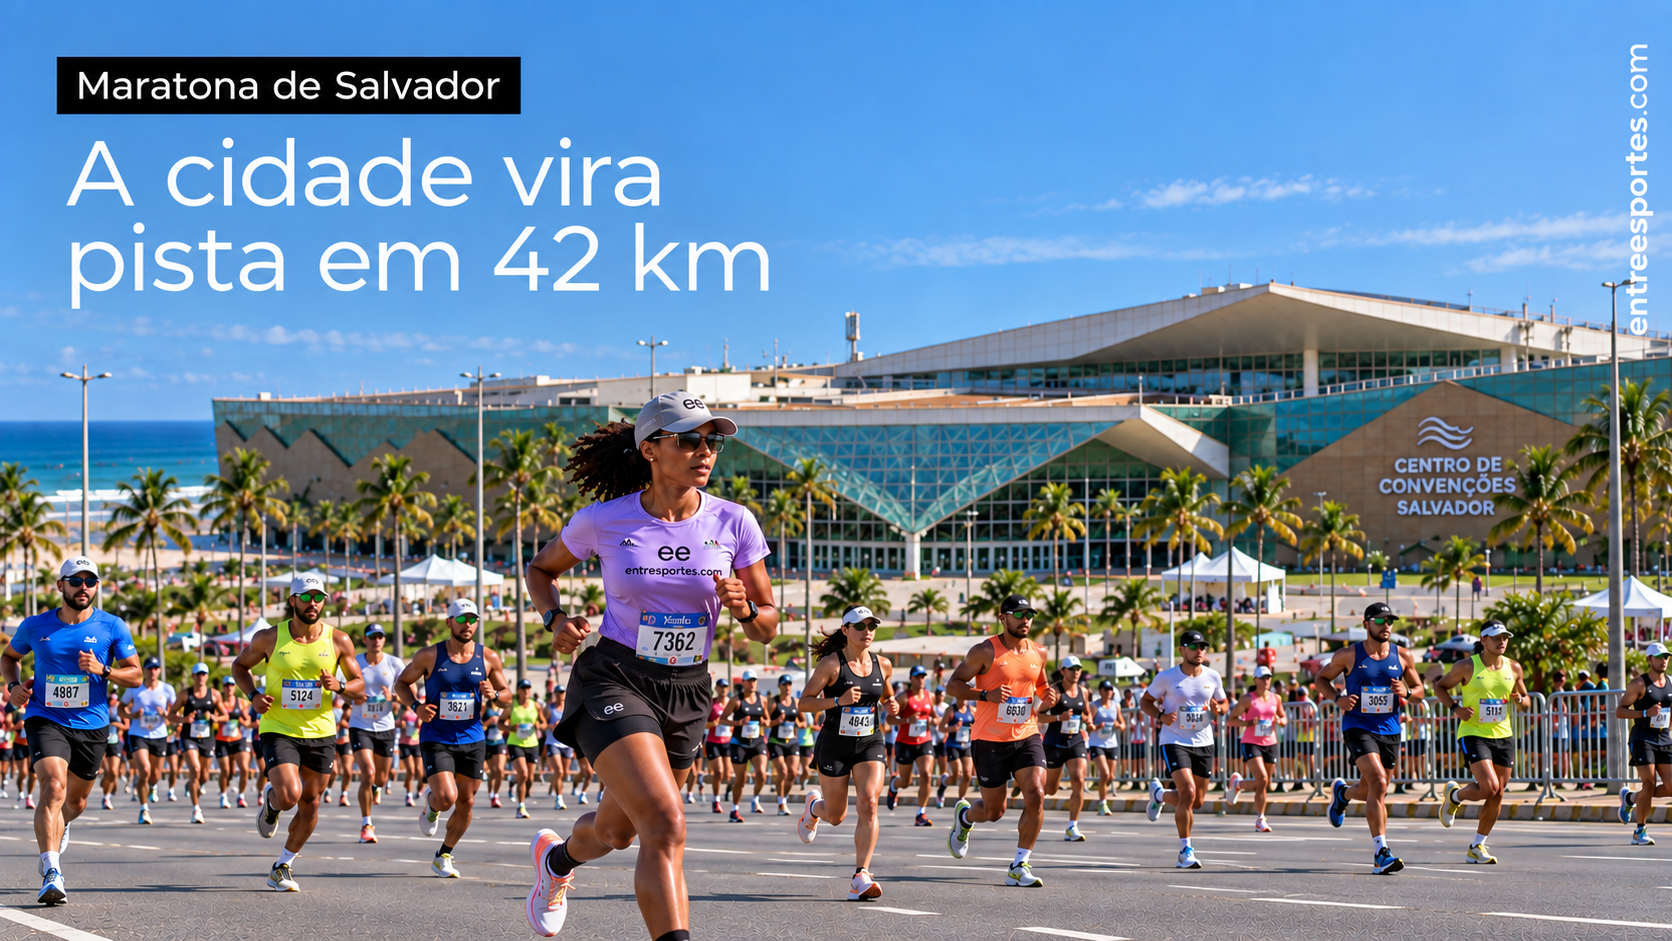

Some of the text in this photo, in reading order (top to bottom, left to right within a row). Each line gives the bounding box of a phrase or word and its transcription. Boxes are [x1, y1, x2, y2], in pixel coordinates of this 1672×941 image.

[683, 399, 705, 410] ee
[1394, 456, 1502, 473] CENTRO DE
[1379, 473, 1516, 498] CONVENÇÕES
[1397, 500, 1495, 515] SALVADOR
[658, 546, 691, 561] ee
[625, 565, 723, 578] entresportes.com
[653, 631, 695, 652] 7362
[290, 690, 313, 701] 5124
[448, 701, 467, 712] 3821
[604, 702, 624, 715] ee
